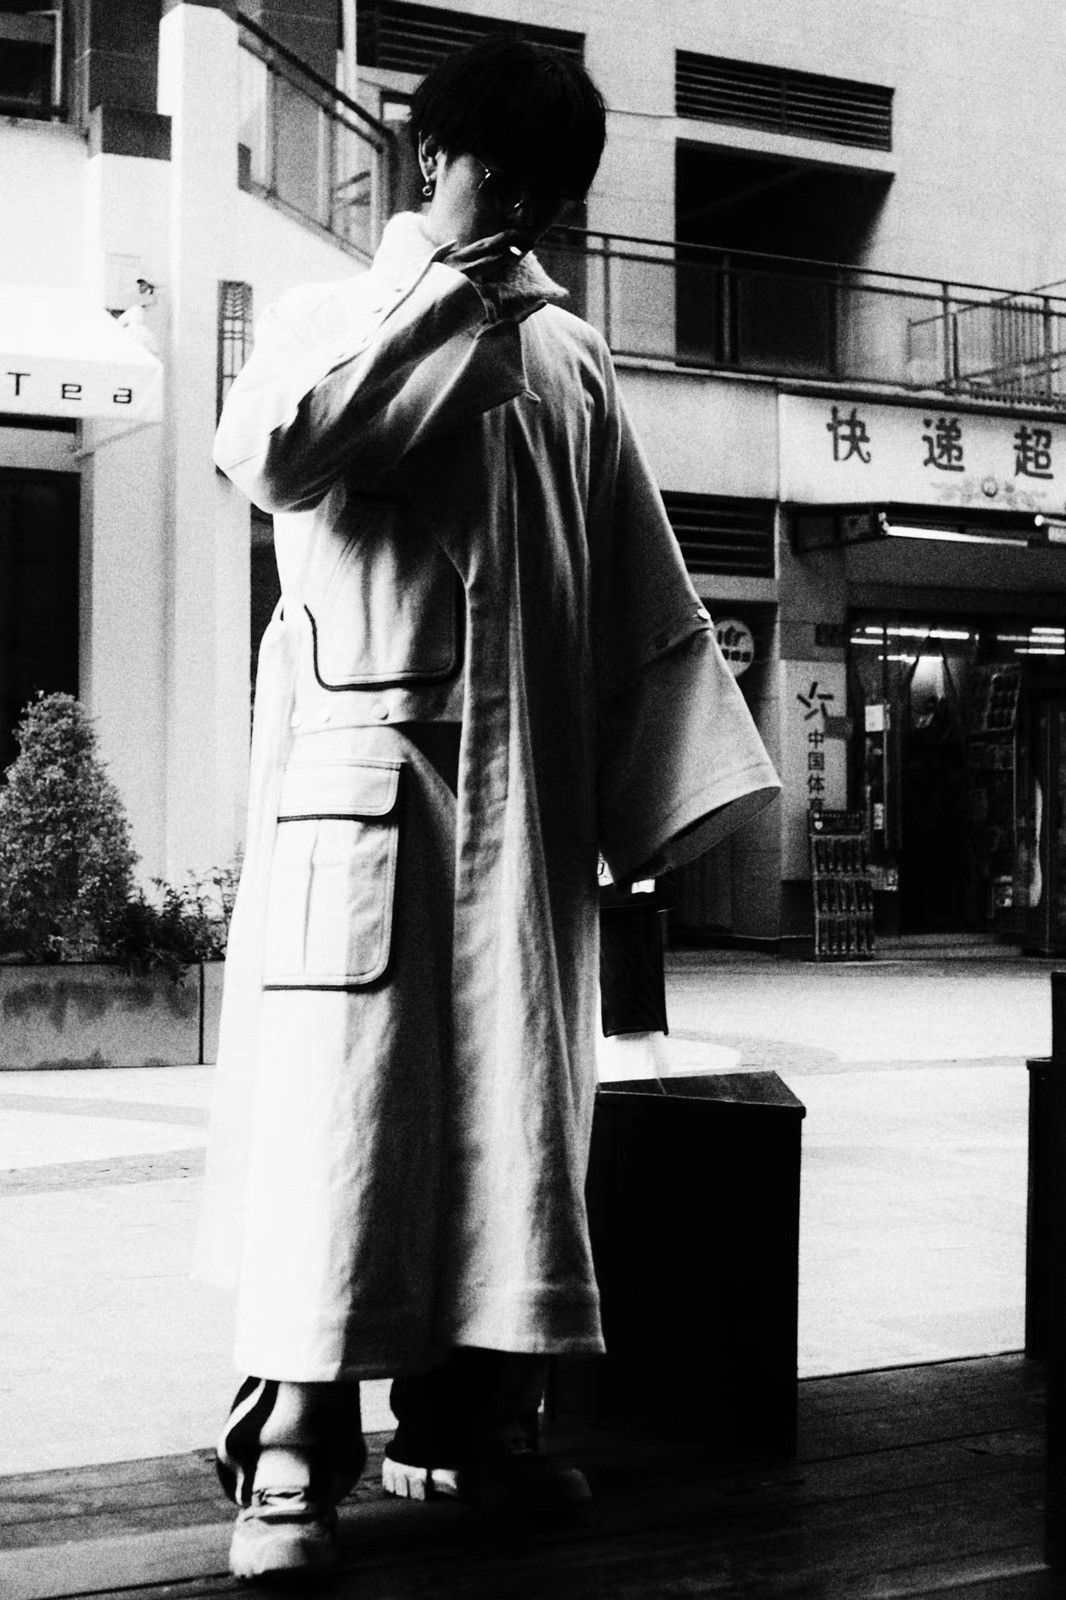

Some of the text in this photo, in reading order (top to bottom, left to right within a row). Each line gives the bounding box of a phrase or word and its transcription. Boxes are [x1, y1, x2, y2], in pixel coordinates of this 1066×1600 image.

[7, 371, 133, 404] Tea
[826, 405, 1054, 480] 快递超
